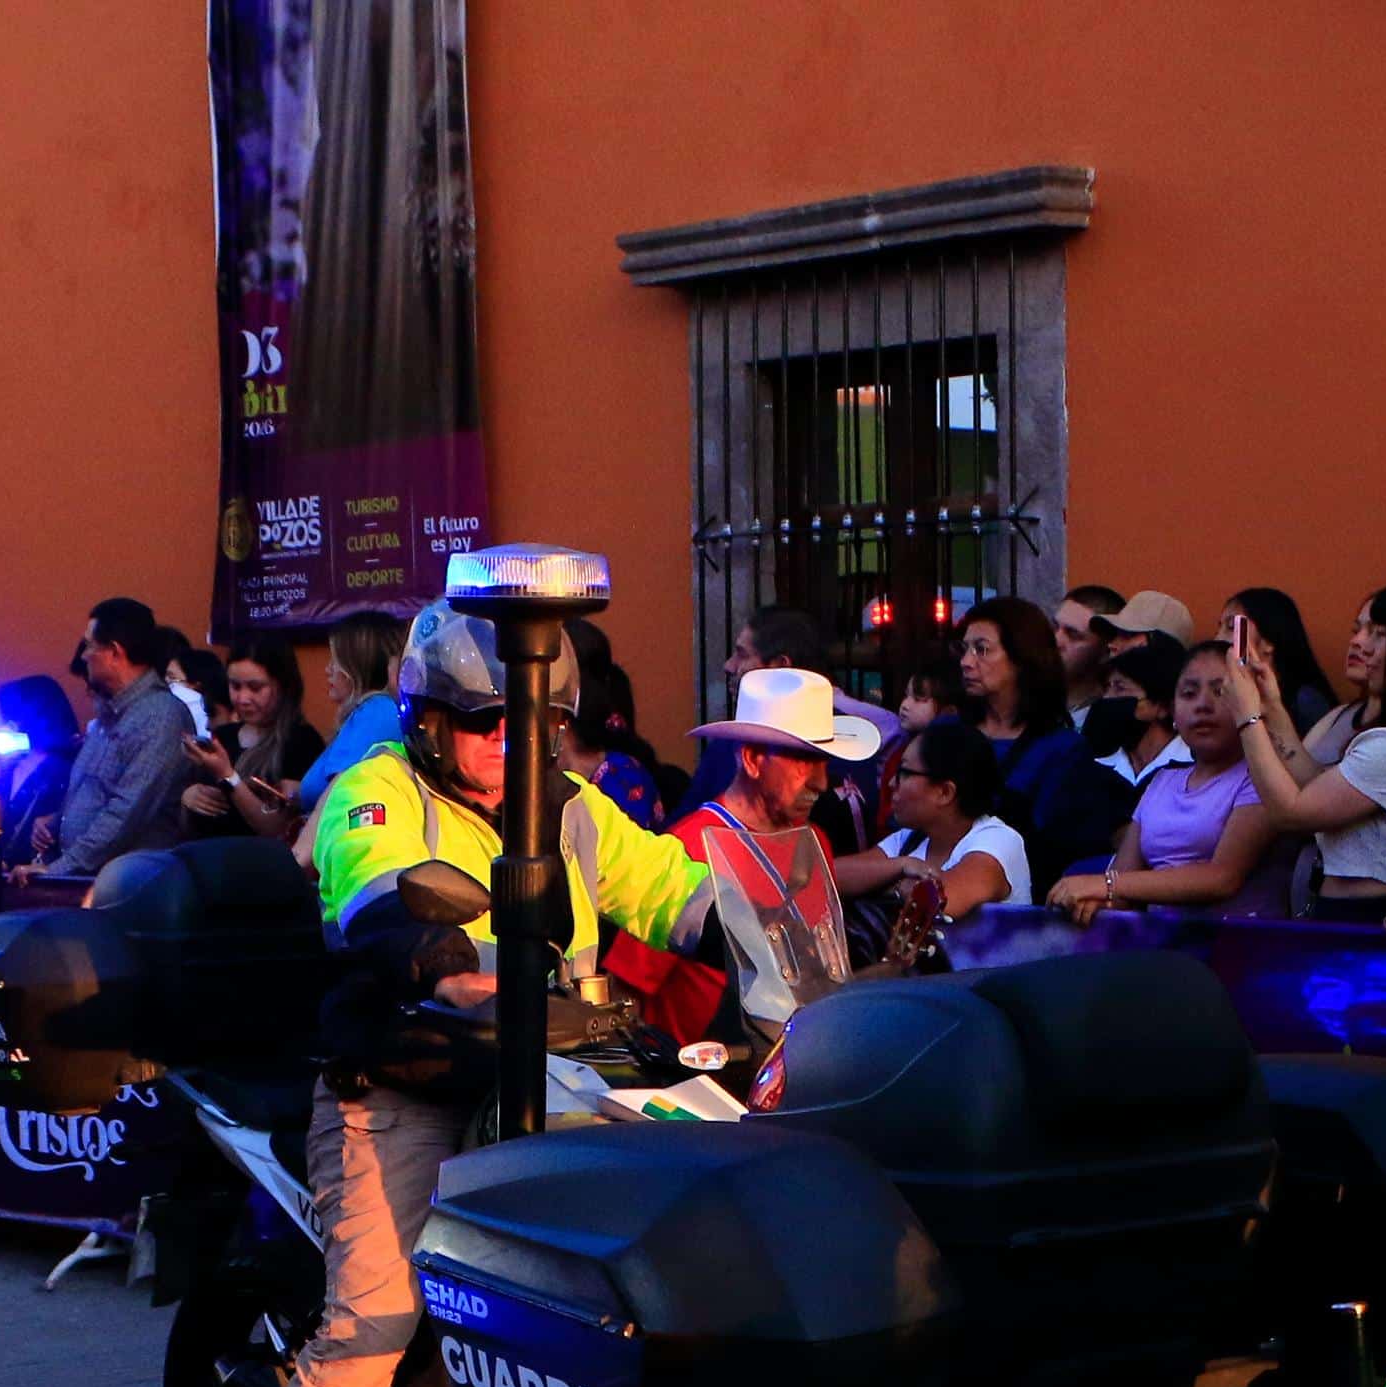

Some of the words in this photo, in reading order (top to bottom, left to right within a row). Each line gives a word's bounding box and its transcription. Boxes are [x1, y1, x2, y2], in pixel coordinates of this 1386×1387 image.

[256, 498, 298, 522] VILLA
[298, 496, 321, 518] DE
[345, 497, 399, 517] TURISMO
[259, 518, 323, 551] POZOS
[423, 517, 436, 535] El
[346, 533, 401, 552] CULTURA
[431, 536, 445, 552] es
[346, 568, 405, 589] DEPORTE
[424, 1279, 490, 1320] SHAD
